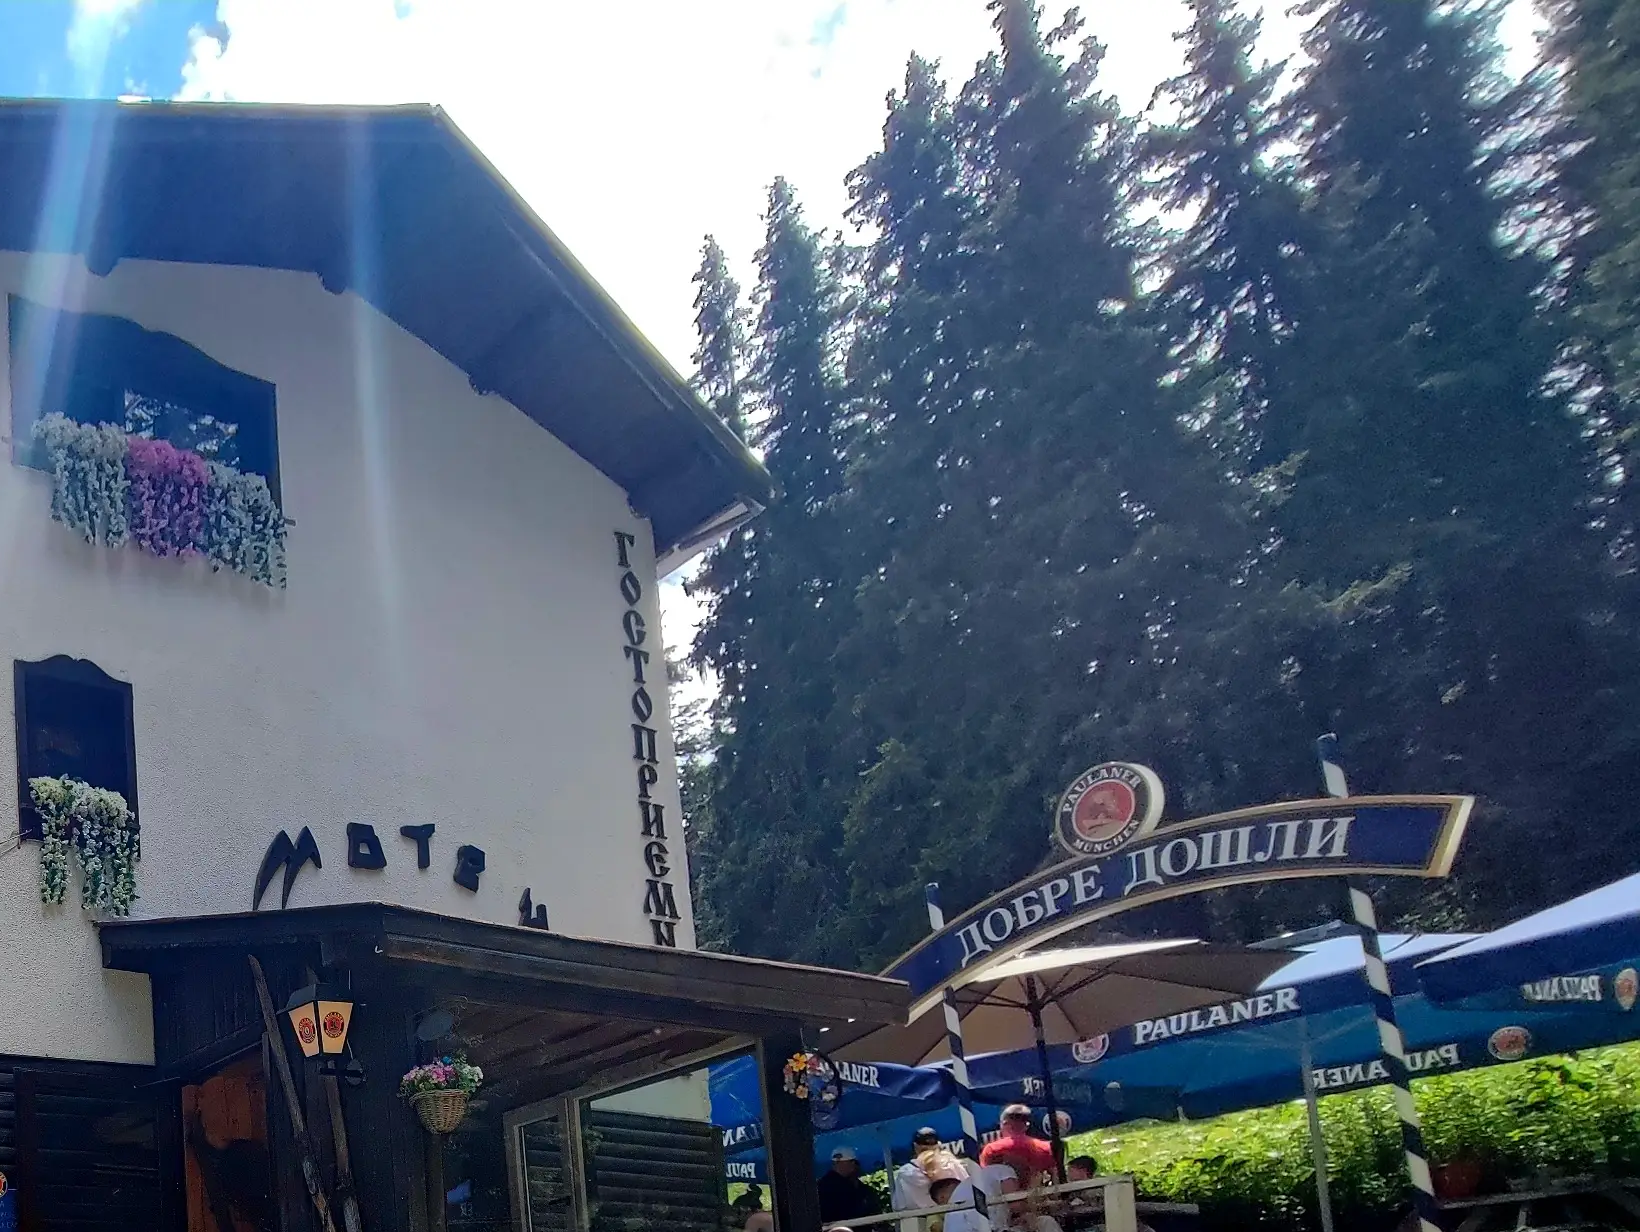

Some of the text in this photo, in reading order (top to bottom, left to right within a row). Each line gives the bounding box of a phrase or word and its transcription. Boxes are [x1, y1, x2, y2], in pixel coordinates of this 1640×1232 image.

[1062, 766, 1141, 813] PAULANER
[954, 815, 1355, 967] ДОБРЕ ДОШЛИ
[1133, 986, 1302, 1046] PAULANER
[820, 1060, 881, 1088] LANER
